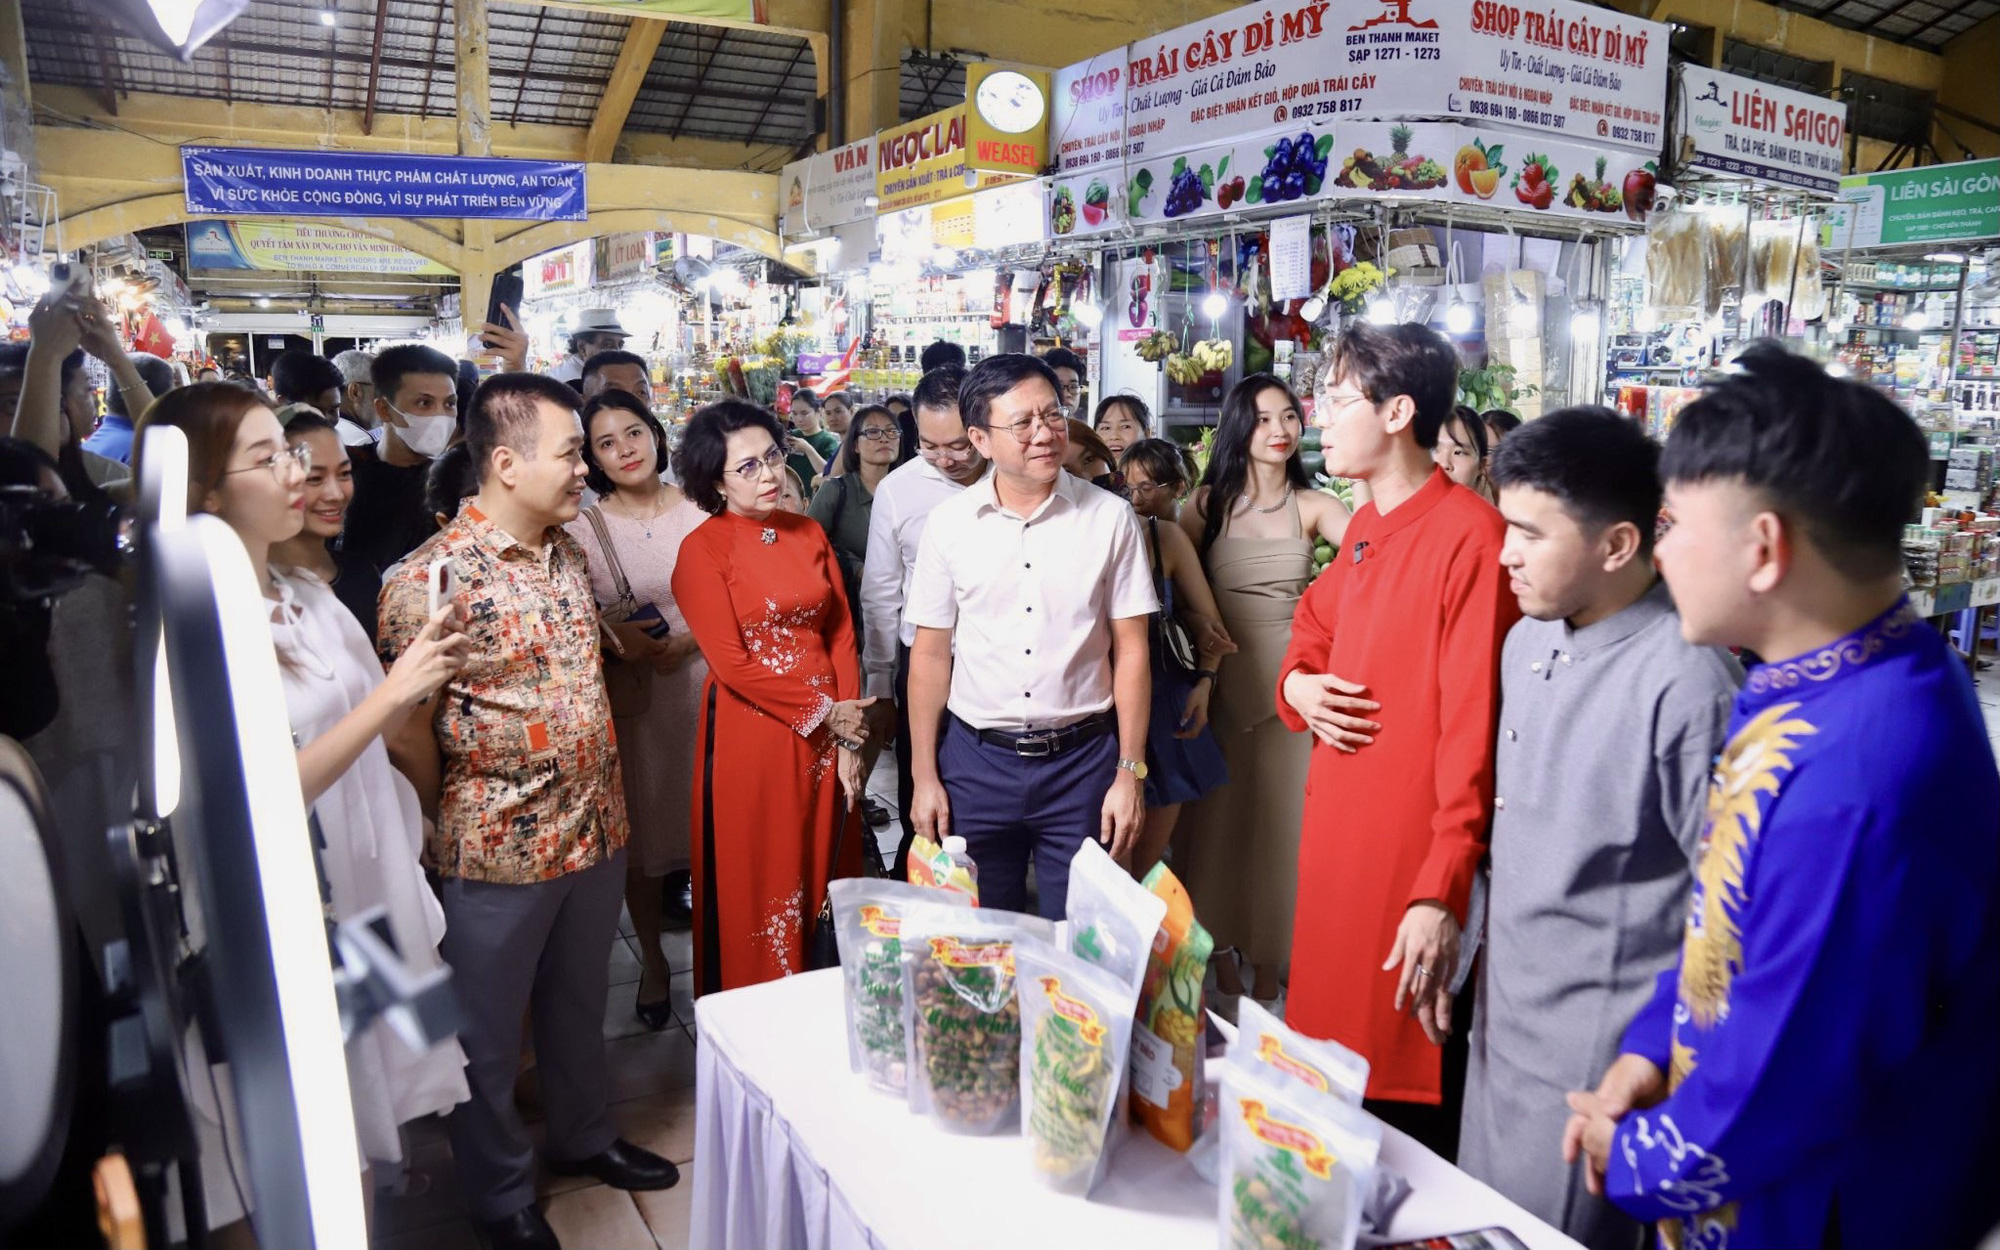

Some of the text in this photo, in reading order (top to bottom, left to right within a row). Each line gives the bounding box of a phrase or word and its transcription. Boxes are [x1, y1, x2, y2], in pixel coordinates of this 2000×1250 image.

[1346, 33, 1440, 45] BEN THANH MAKET
[1471, 0, 1520, 39] SHOP
[1524, 8, 1564, 50] TRÁI
[1568, 16, 1601, 59] CÂY
[1070, 67, 1120, 102] SHOP
[1127, 45, 1179, 88] TRÁI
[1184, 29, 1237, 71] CÂY
[1348, 47, 1440, 64] SẠP 1271 1273
[1191, 76, 1208, 98] Giá
[1210, 73, 1224, 92] Cả
[1226, 67, 1251, 89] Đảm
[1254, 59, 1276, 82] Bảo
[1248, 94, 1262, 108] KẾT
[1281, 86, 1299, 103] HỘP
[1301, 78, 1320, 98] QUÀ
[1323, 74, 1348, 93] TRÁI
[1352, 72, 1376, 89] CÂY
[1292, 98, 1362, 119] 0932 758 817
[1470, 100, 1488, 114] 0938
[1489, 103, 1502, 117] 694
[1505, 106, 1517, 120] 160
[1553, 114, 1565, 129] 507
[1732, 88, 1777, 133] LIÊN
[879, 124, 932, 172] NGỌC
[1612, 125, 1628, 140] 0932
[1630, 128, 1642, 143] 758
[834, 144, 869, 174] VÂN
[976, 139, 1039, 168] WEASEL
[1121, 145, 1131, 157] 37
[1132, 141, 1144, 155] 507
[194, 161, 573, 188] SẢN XUẤT, KINH DOANH THỰC PHẨM CHẤT LƯỢNG, AN TOÀN
[1891, 180, 1928, 201] LIÊN
[1930, 177, 1959, 198] SÀI
[1962, 172, 2000, 194] GÒN
[210, 185, 562, 209] VÌ SỨC KHỎE CỘNG ĐỒNG, VÌ SỰ PHÁT TRIỂN BỀN VỮNG
